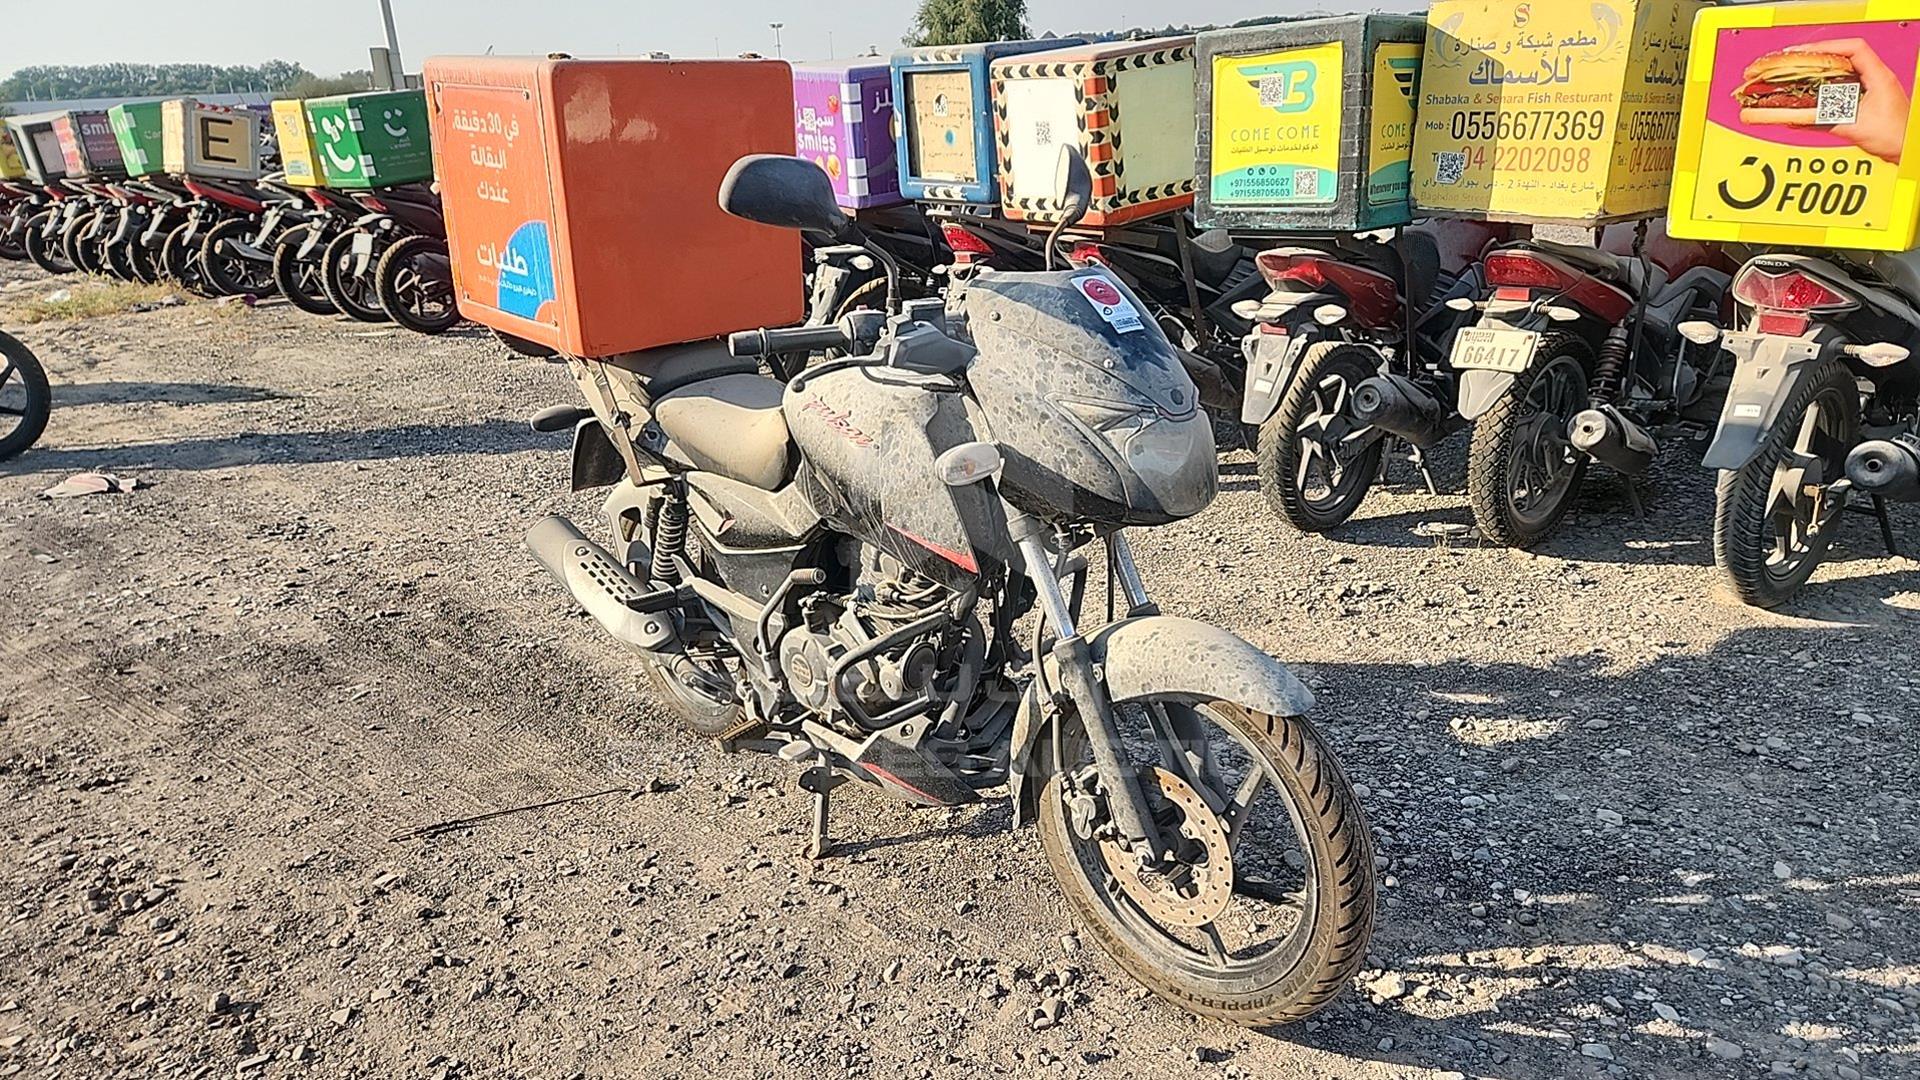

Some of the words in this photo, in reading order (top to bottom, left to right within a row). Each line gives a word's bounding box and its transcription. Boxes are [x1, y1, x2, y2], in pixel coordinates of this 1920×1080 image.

[1453, 36, 1497, 56] صنارة
[1502, 42, 1512, 54] و
[1516, 31, 1554, 53] شبكة
[1558, 30, 1598, 54] مطعم
[1468, 48, 1573, 86] للأسماك
[1425, 93, 1470, 105] Shabaka
[1473, 93, 1482, 104] &
[1486, 92, 1525, 105] Senara
[1527, 91, 1552, 105] Fish
[1554, 91, 1613, 104] Resturant
[82, 118, 111, 136] smi
[452, 108, 488, 138] دقيقة
[486, 111, 502, 135] 30
[504, 112, 520, 149] في
[1231, 128, 1270, 142] COME
[1277, 125, 1320, 140] COME
[1425, 121, 1444, 132] Mob
[1450, 110, 1605, 141] 0556677369
[1629, 110, 1681, 141] 05566773
[200, 116, 237, 163] E
[797, 130, 836, 153] smiles
[471, 144, 508, 174] البقالة
[1491, 147, 1591, 174] 2202098
[1786, 157, 1872, 176] noon
[476, 180, 511, 204] عندك
[1775, 182, 1868, 216] FOOD
[476, 241, 529, 279] طلبات
[1754, 259, 1790, 267] HONDA
[1463, 345, 1520, 367] 66417
